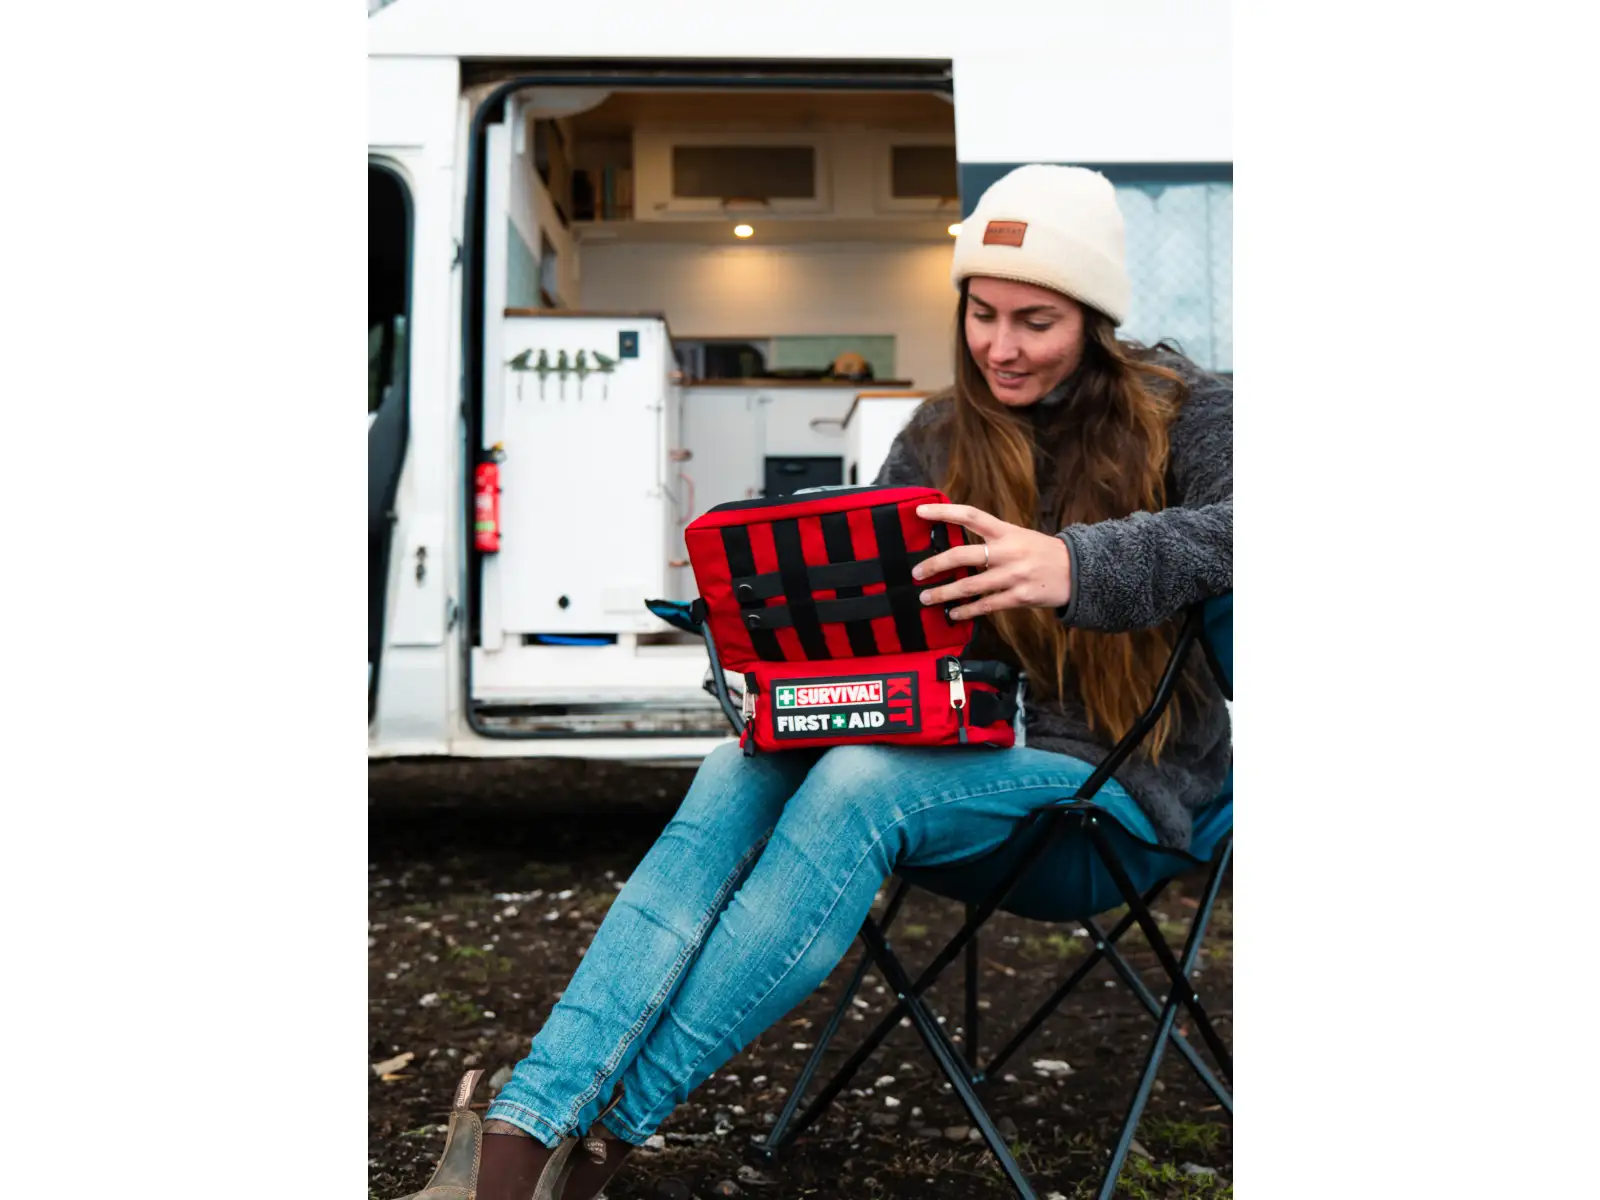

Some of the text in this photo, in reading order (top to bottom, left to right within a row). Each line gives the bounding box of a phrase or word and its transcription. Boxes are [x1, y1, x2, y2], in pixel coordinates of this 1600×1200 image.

[797, 683, 879, 705] SURVIVAL
[886, 677, 914, 726] KIT
[777, 711, 885, 732] FIRST AID
